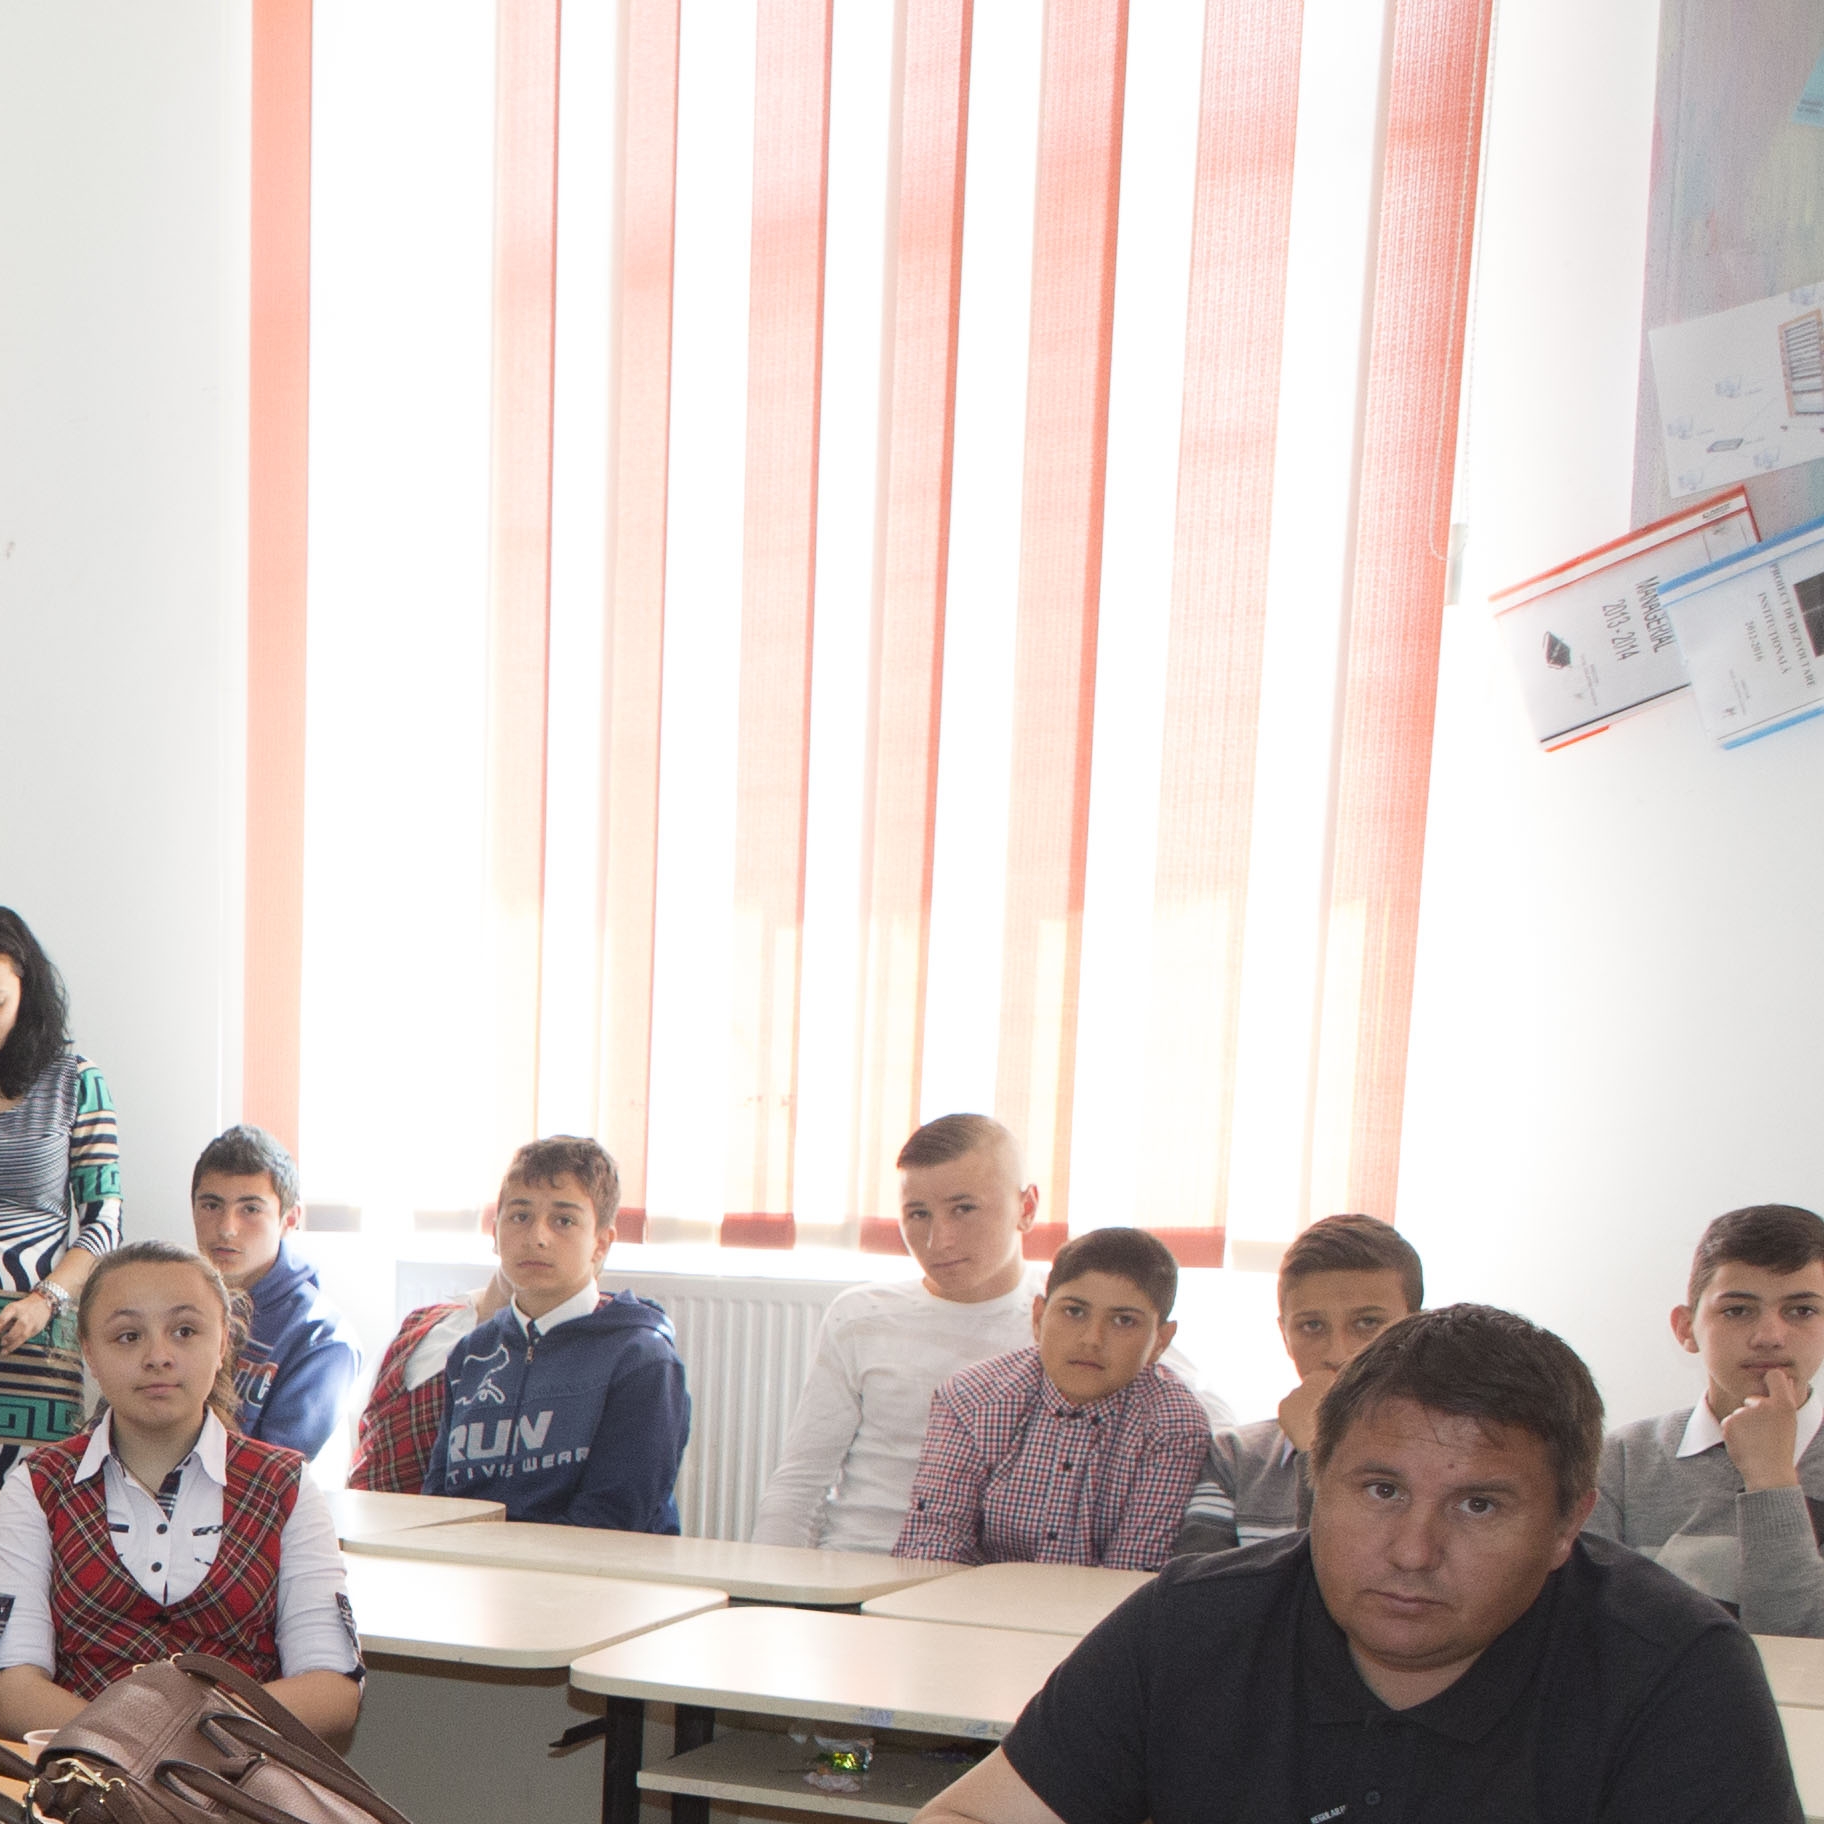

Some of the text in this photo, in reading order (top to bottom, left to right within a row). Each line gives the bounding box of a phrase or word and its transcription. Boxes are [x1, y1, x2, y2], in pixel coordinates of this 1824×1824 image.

[1602, 598, 1631, 630] 2013
[1610, 631, 1641, 662] 2014
[522, 1446, 590, 1473] WEAR
